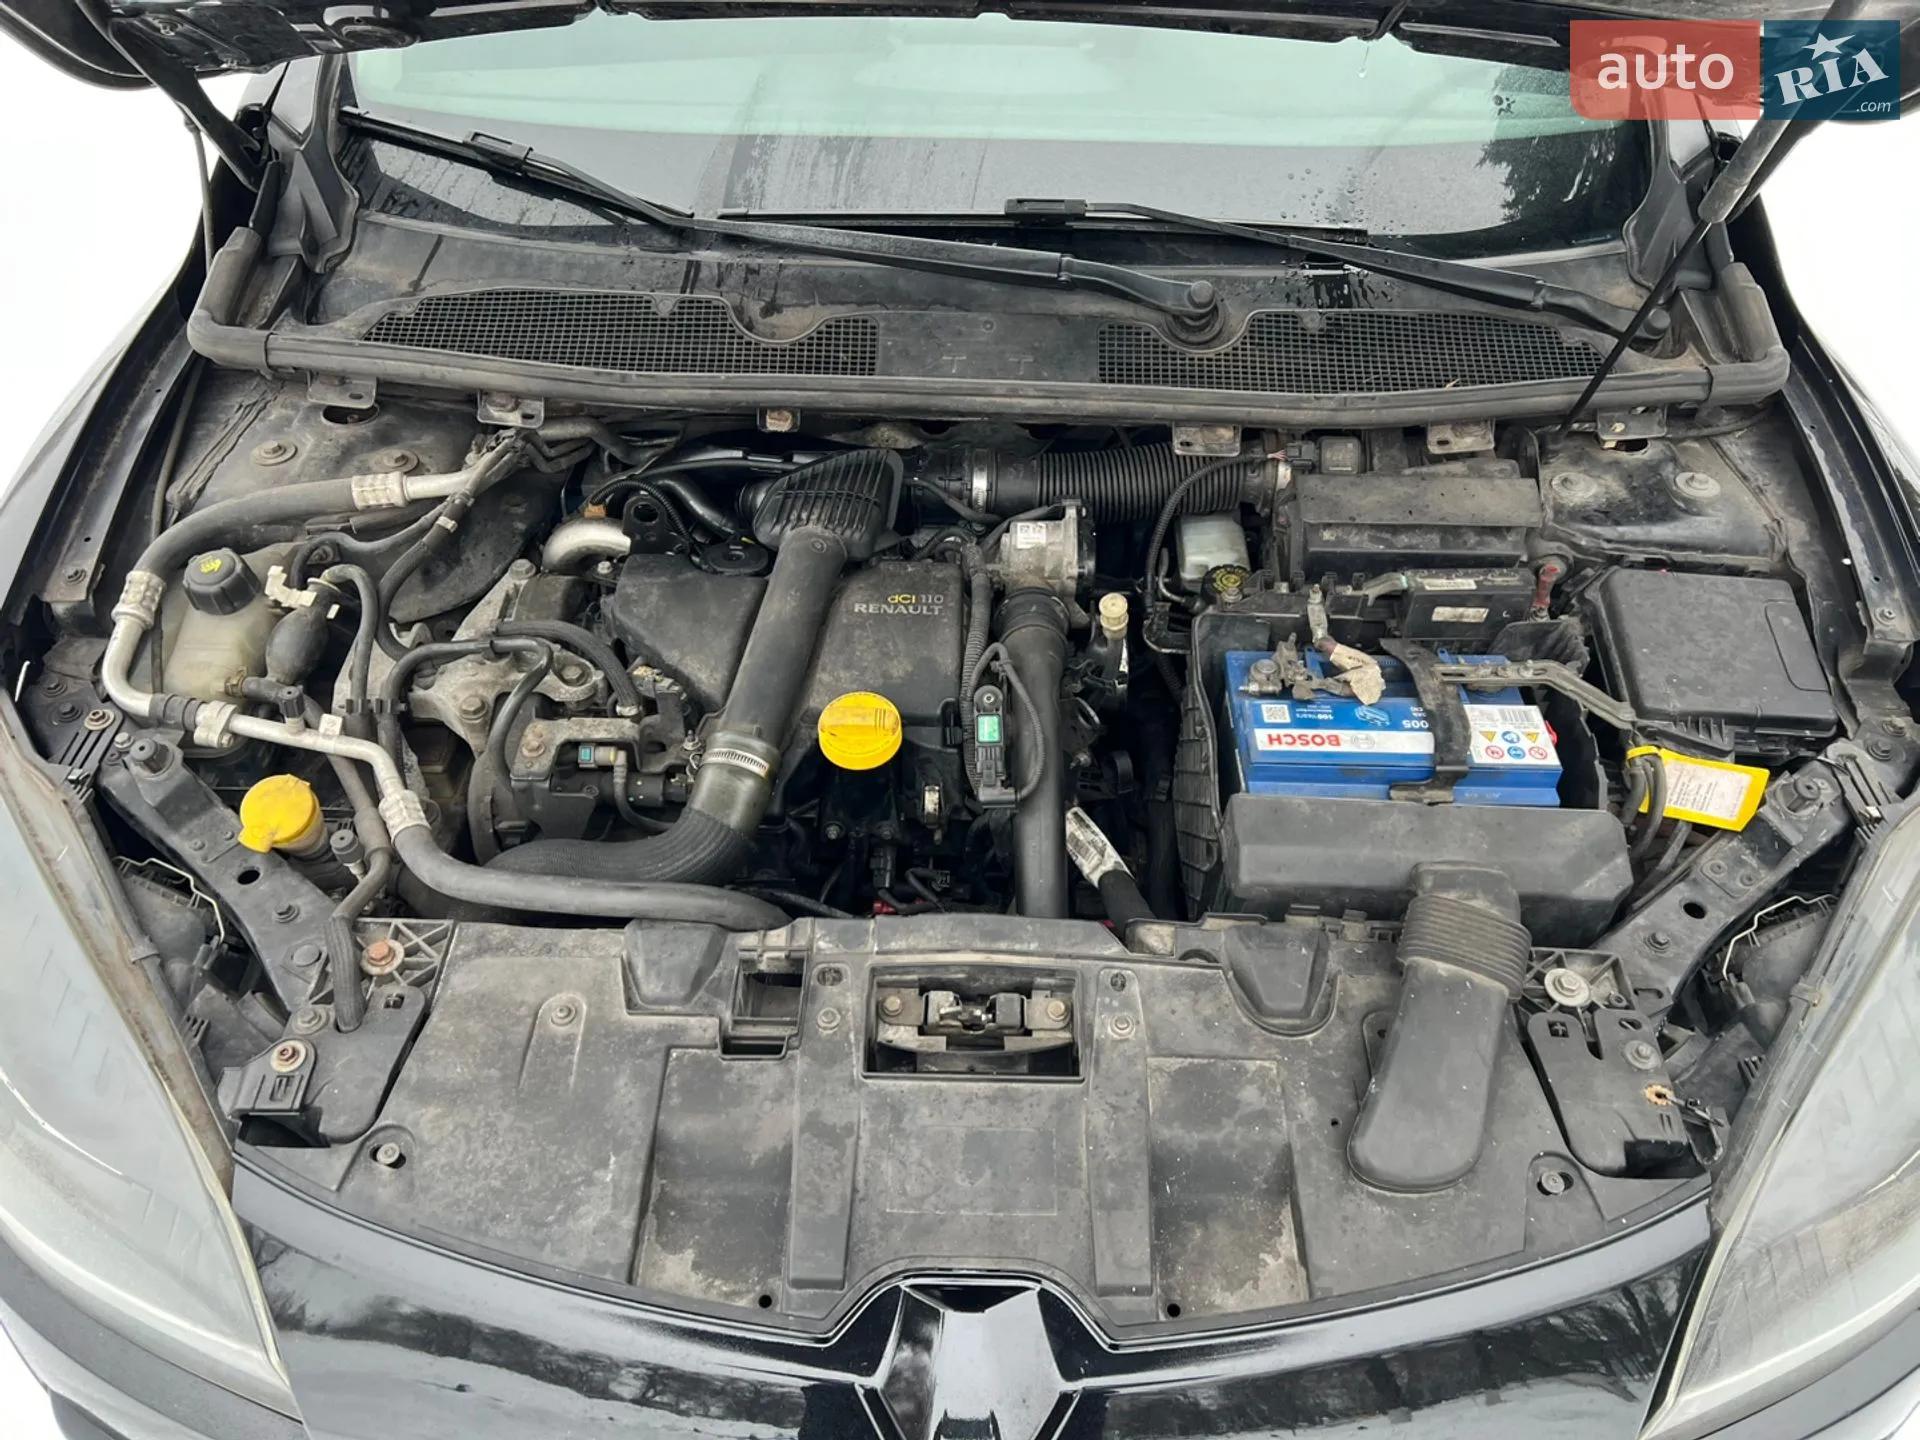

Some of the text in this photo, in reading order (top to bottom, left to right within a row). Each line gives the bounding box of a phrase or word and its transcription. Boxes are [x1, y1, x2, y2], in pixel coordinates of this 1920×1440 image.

[920, 594, 944, 604] 110
[854, 603, 943, 615] RENAULT
[1267, 734, 1341, 747] BOSCH
